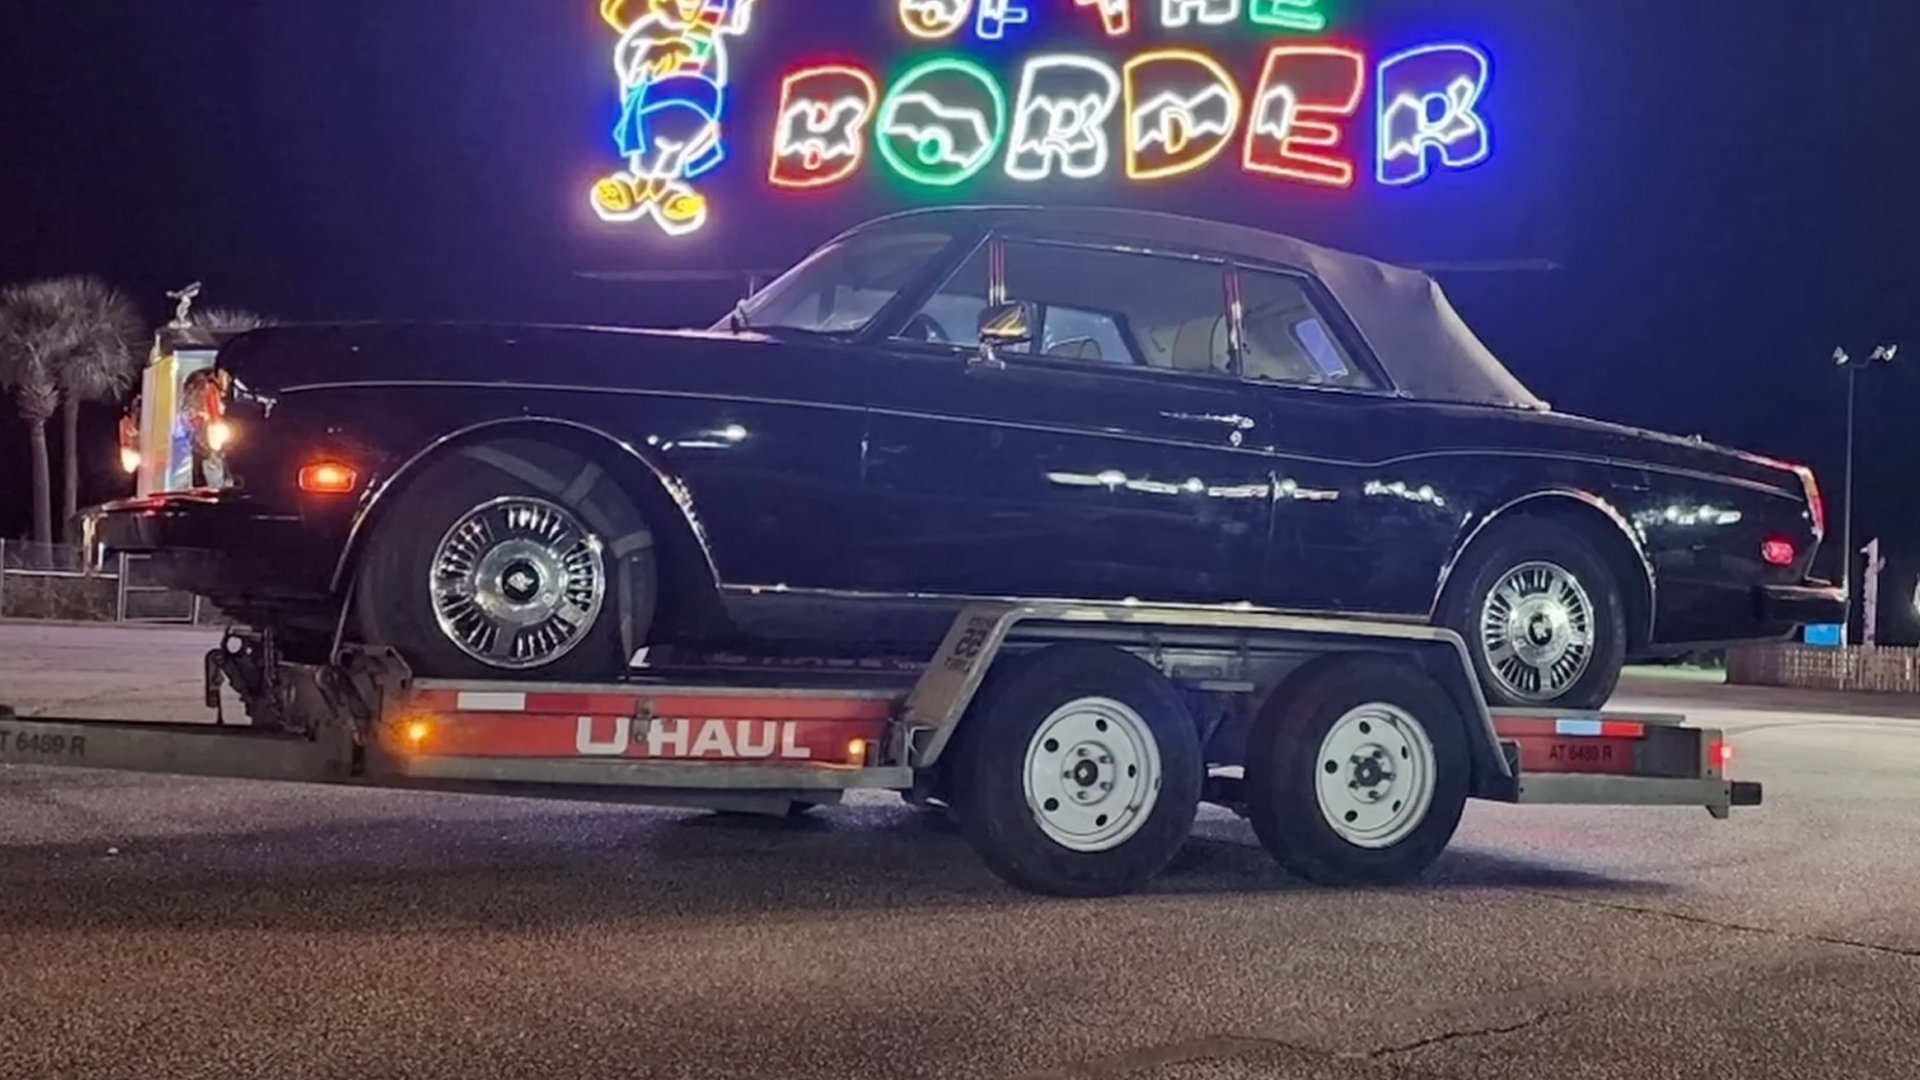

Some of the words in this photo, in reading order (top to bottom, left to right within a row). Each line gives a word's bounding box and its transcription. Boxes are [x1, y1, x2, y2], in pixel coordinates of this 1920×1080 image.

[770, 44, 1488, 187] BORDER
[70, 735, 86, 756] R
[576, 716, 811, 758] UHAUL
[1549, 744, 1567, 761] AT
[1602, 745, 1612, 761] R
